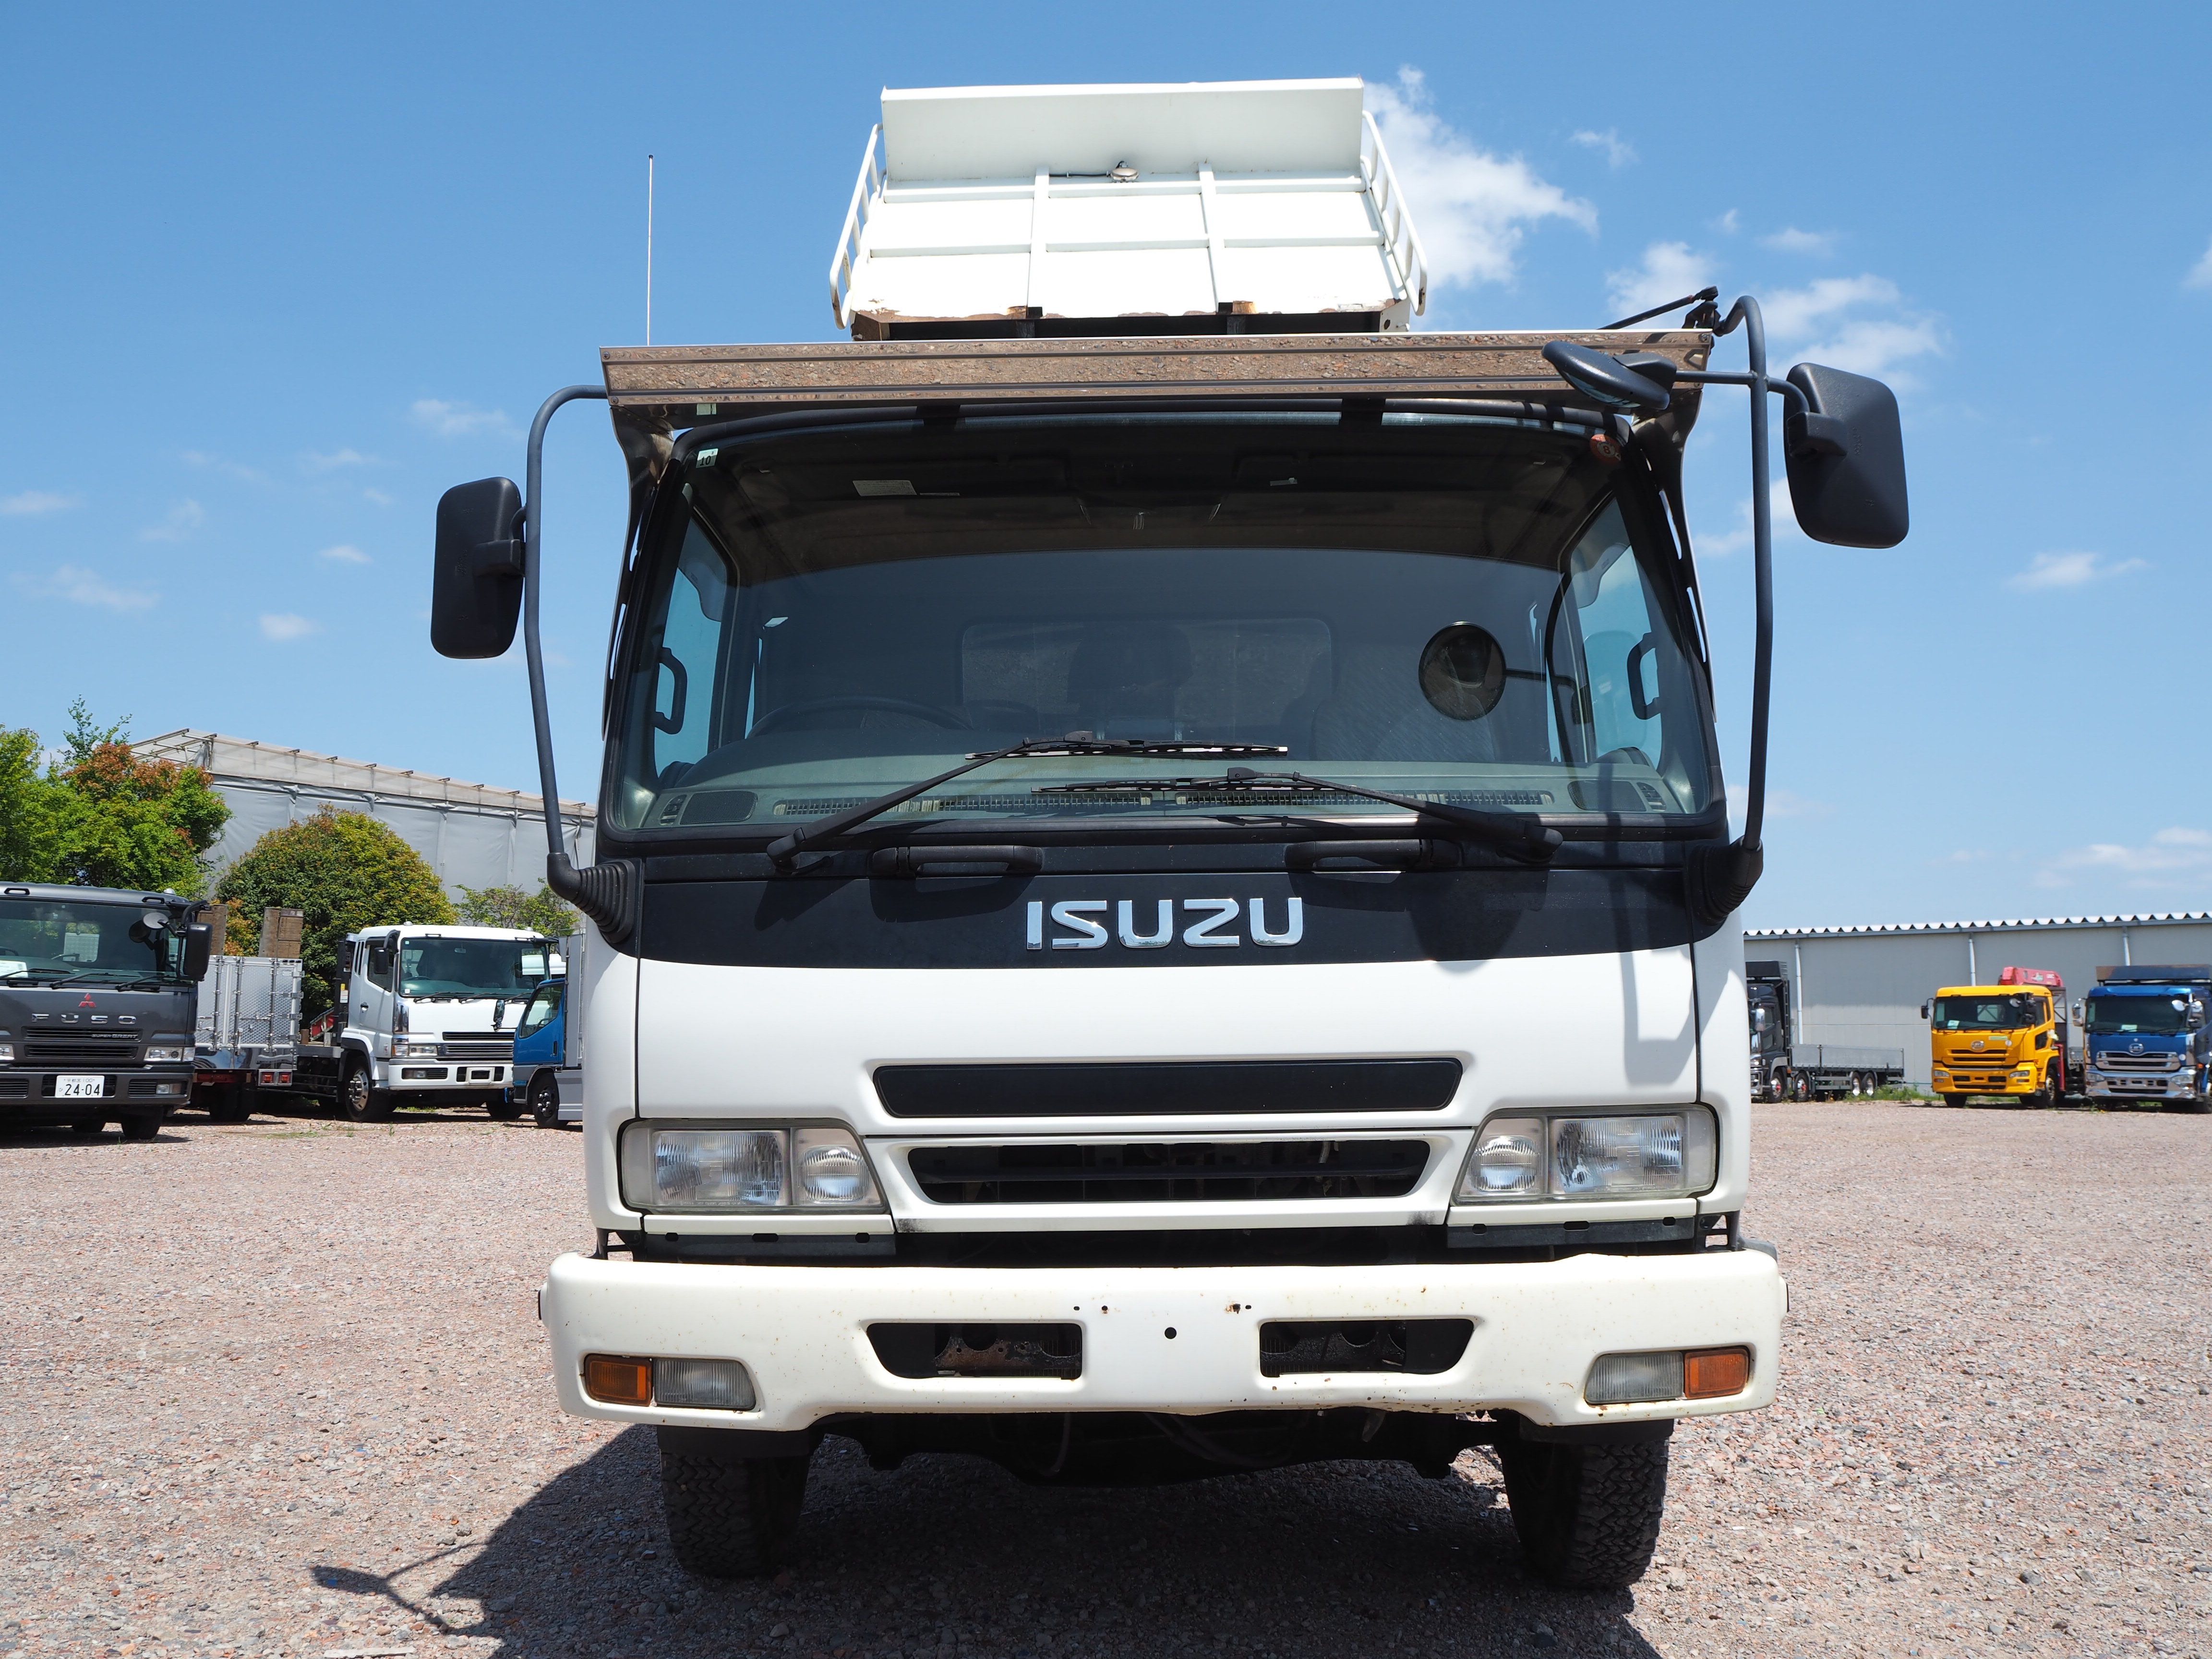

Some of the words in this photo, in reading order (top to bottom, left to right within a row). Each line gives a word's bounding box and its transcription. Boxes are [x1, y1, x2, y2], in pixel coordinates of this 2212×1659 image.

[1603, 445, 1611, 455] 8
[699, 456, 711, 466] 10
[1026, 897, 1303, 950] ISUZU
[31, 1013, 137, 1025] FUSO
[64, 1083, 100, 1096] 24-04
